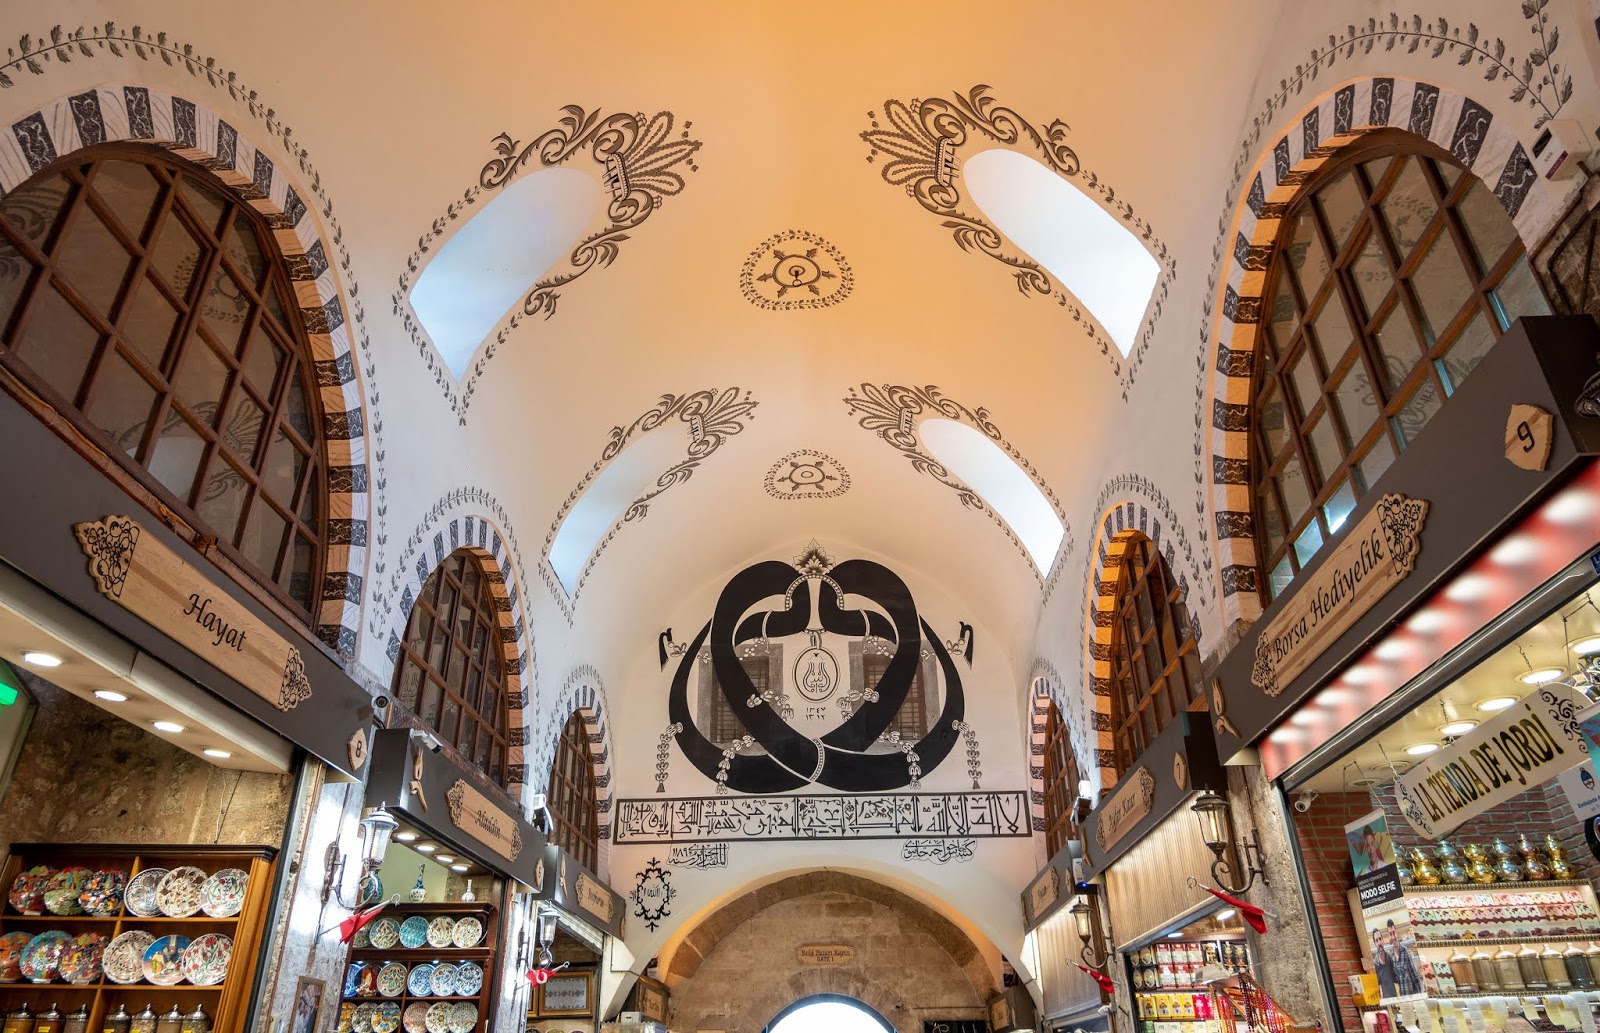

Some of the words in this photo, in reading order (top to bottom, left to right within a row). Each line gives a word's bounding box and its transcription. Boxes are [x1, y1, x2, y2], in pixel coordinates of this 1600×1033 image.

[1517, 421, 1535, 453] 9
[1273, 617, 1309, 664] Borsa
[1310, 528, 1384, 627] Hediyelik
[183, 593, 247, 652] Hayat
[355, 740, 363, 758] 8
[1413, 782, 1446, 823] LA
[1470, 742, 1513, 789] DE
[1361, 887, 1378, 900] MODO
[1378, 881, 1396, 895] SELFIE
